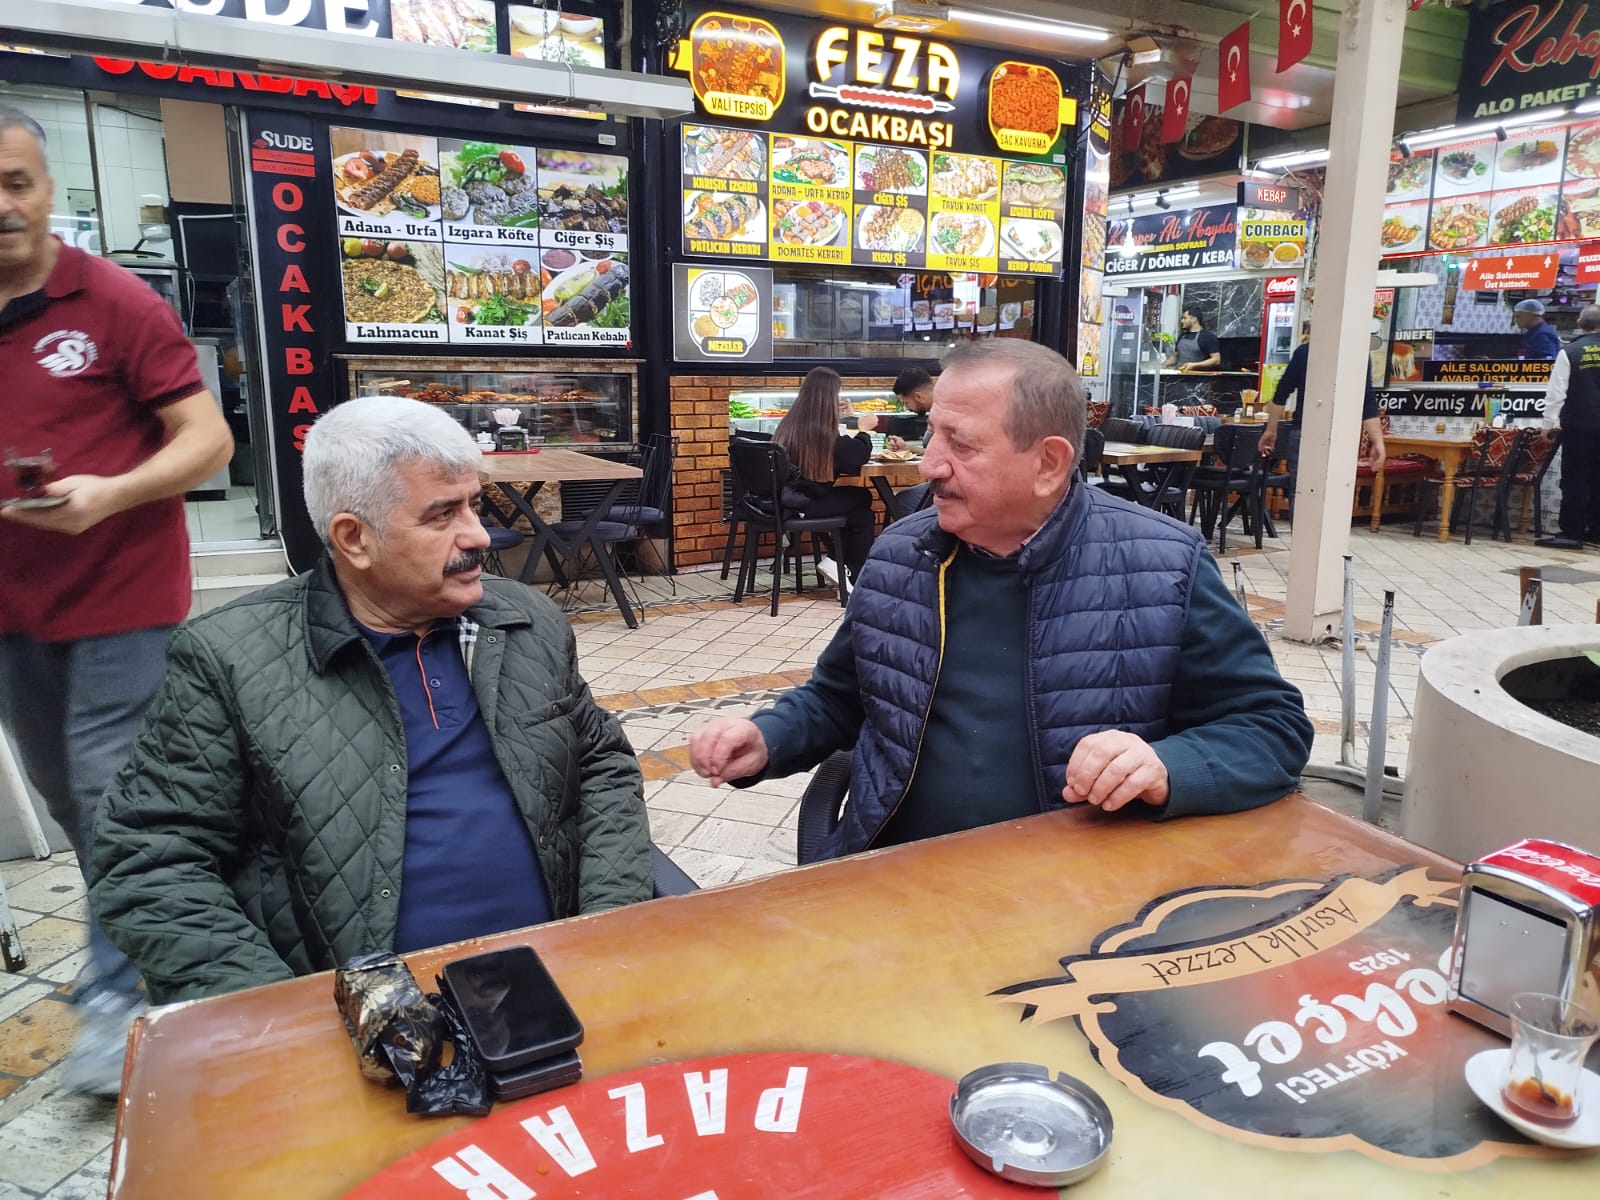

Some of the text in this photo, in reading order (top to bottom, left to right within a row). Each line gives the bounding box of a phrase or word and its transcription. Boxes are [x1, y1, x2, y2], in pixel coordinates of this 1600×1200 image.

[815, 26, 961, 101] FEZA
[711, 97, 768, 116] VALİ TEPSİSİ
[1474, 98, 1515, 118] ALO
[1519, 82, 1592, 110] PAKET
[806, 106, 954, 151] OCAKBAŞI
[262, 130, 314, 151] SUDE
[1015, 136, 1047, 149] KAVURMA
[772, 185, 796, 196] ADANA
[805, 189, 824, 198] URFA
[827, 191, 850, 201] KEBAP
[1257, 188, 1287, 203] KEBAP
[942, 200, 987, 213] TAVUK KANAT
[344, 220, 392, 235] Adana
[406, 224, 437, 237] Urfa
[448, 225, 534, 241] Izgara Köfte
[1159, 215, 1183, 242] Ali
[1245, 223, 1304, 241] ÇORBACI
[554, 231, 614, 250] Ciğer Şiş
[778, 246, 843, 260] DOMATES KEBABI
[945, 257, 967, 266] TAVUK
[1106, 260, 1138, 273] CİĞER
[1148, 253, 1190, 269] DÖNER
[1479, 271, 1540, 280] Aile Salonumuz
[1485, 280, 1498, 288] Üst
[356, 326, 439, 339] Lahmacun
[464, 327, 528, 341] Kanat Şiş
[547, 330, 627, 342] Patlıcan Kebabı
[1439, 361, 1466, 372] AİLE
[1469, 363, 1518, 373] SALONU
[1412, 393, 1465, 414] Yemiş
[1141, 934, 1268, 988] Lezzet
[1349, 947, 1411, 977] 1925
[1275, 1040, 1409, 1105] KÖFTECİ
